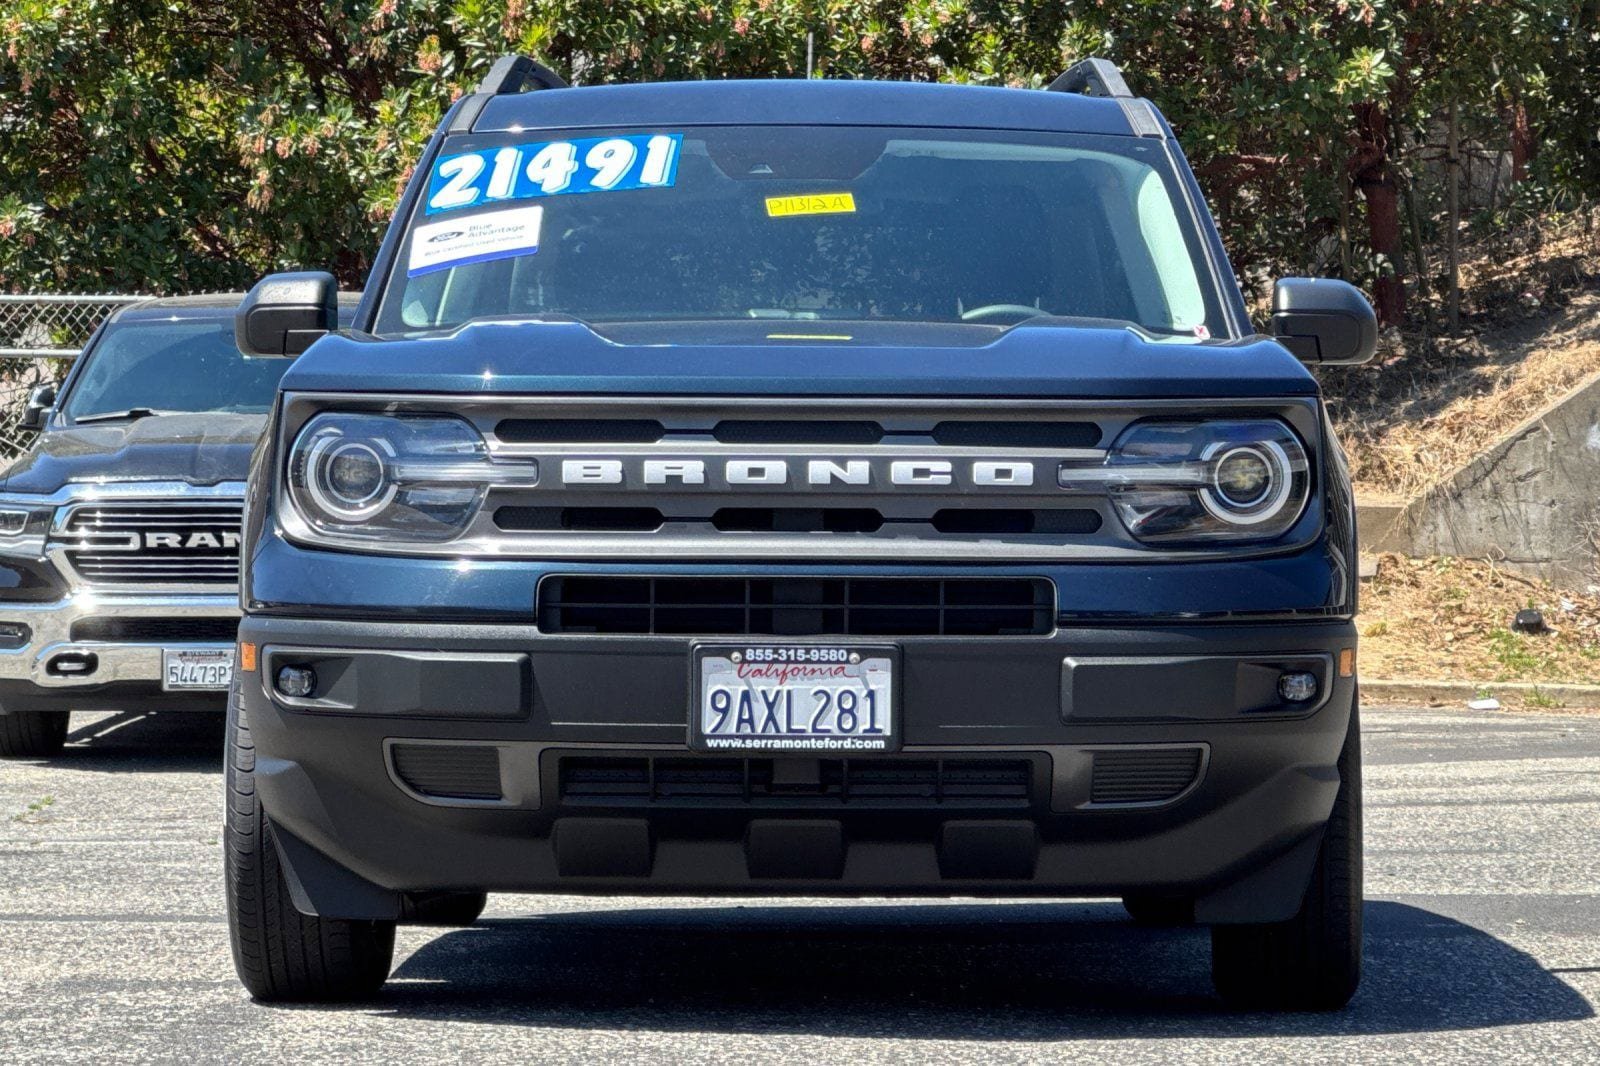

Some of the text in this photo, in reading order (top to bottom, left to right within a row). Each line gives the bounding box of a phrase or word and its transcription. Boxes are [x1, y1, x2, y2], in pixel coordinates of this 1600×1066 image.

[430, 136, 677, 209] 21491
[562, 459, 1034, 486] BRONCO
[745, 648, 848, 662] 855-315-9580
[736, 662, 860, 685] California
[709, 688, 883, 734] 9AXL281
[705, 738, 885, 749] www.serramonteford.com
